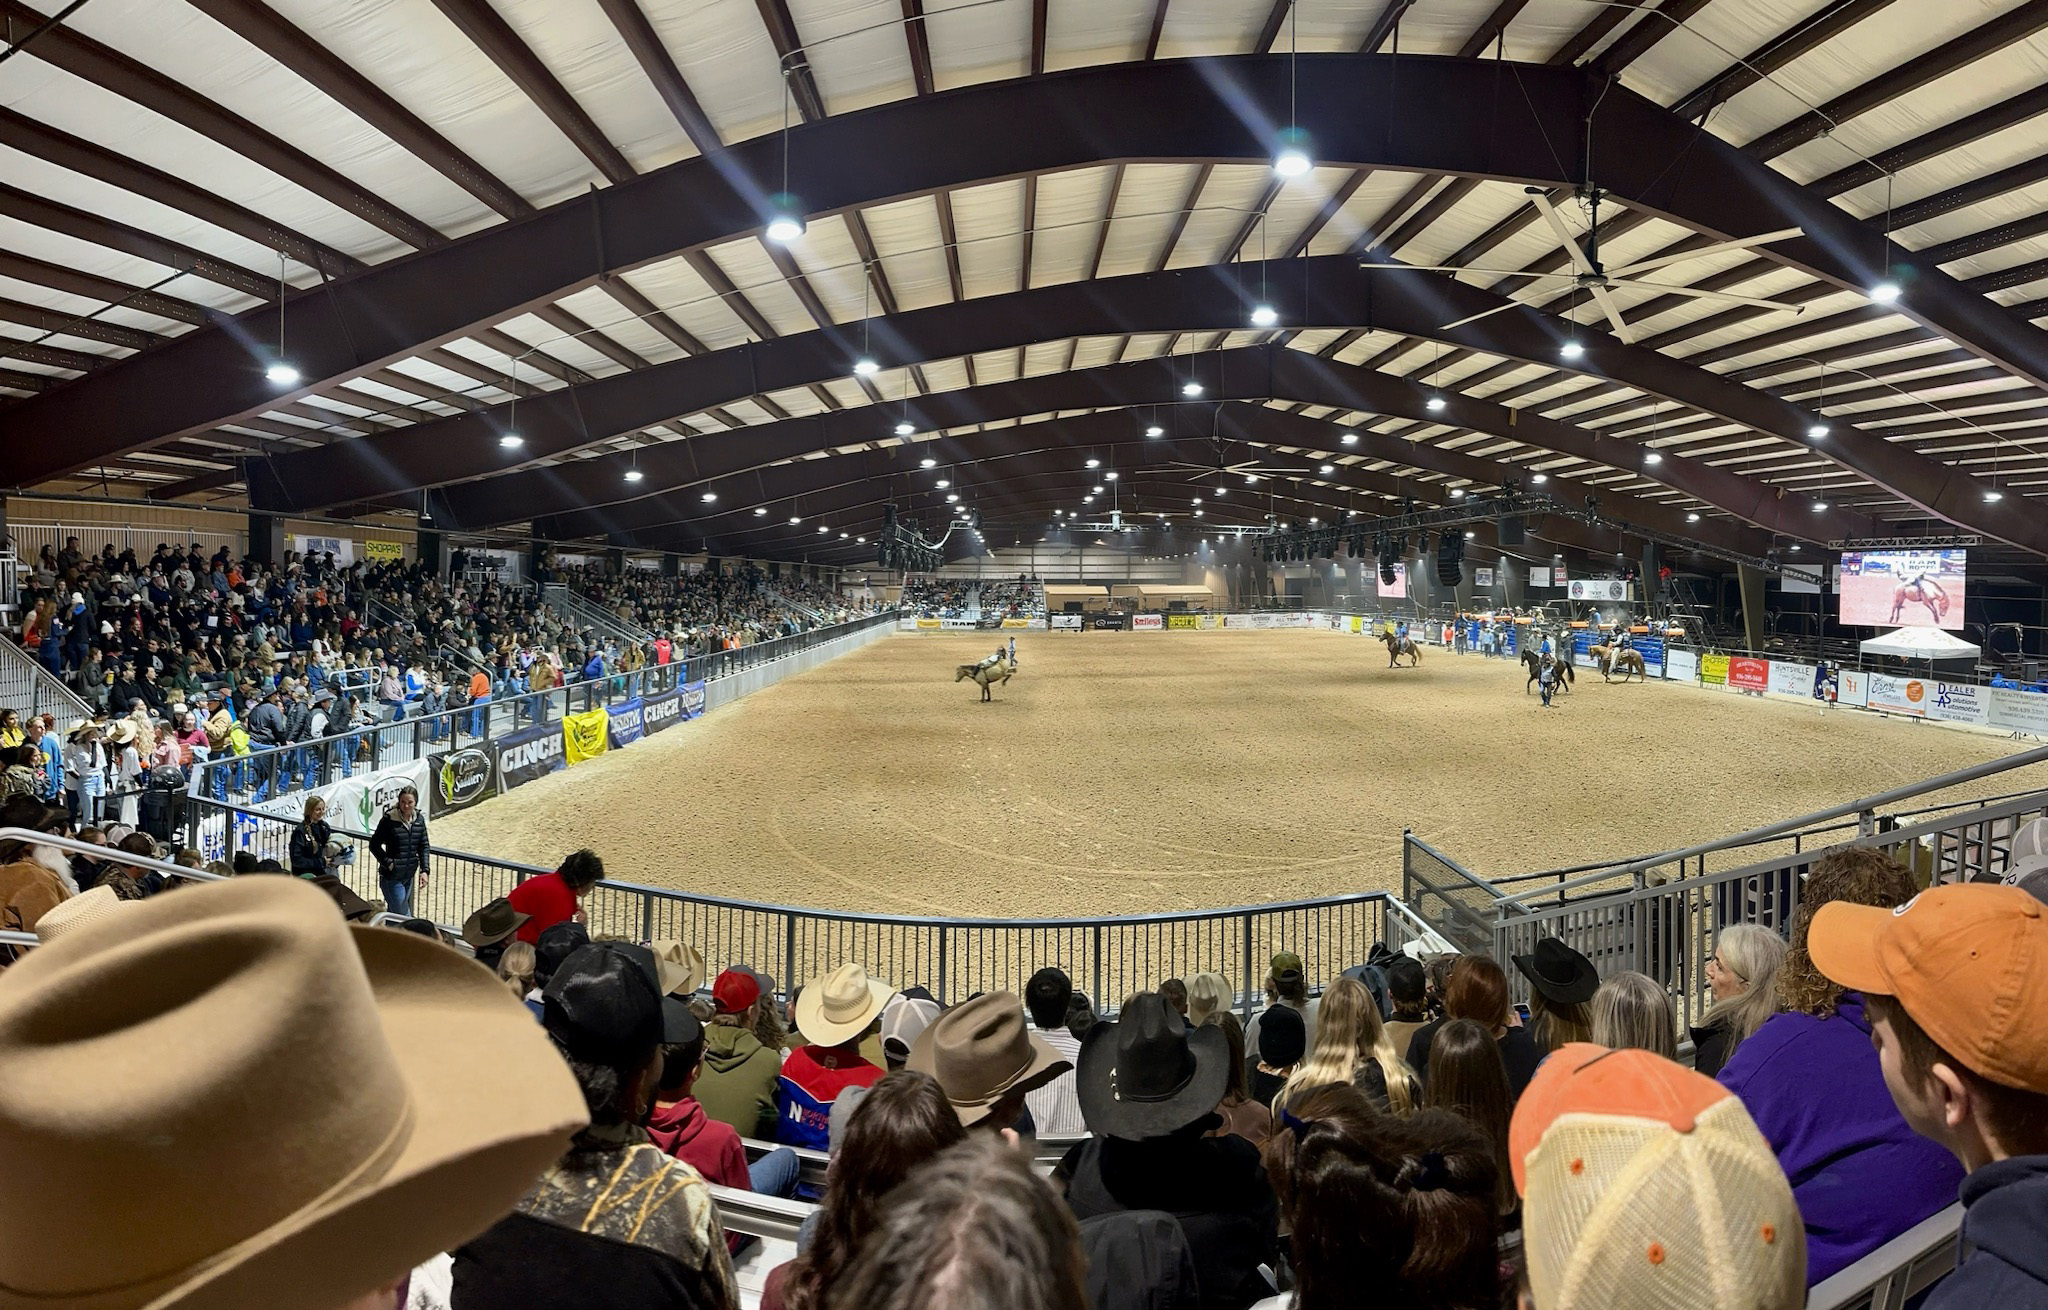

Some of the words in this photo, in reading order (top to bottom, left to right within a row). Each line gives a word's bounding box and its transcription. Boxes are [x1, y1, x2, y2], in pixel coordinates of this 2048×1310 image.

[367, 542, 401, 554] SHOPPA'S
[1775, 664, 1810, 676] HUNTSVILLE
[643, 698, 680, 723] CINCH
[501, 733, 563, 773] CINCH
